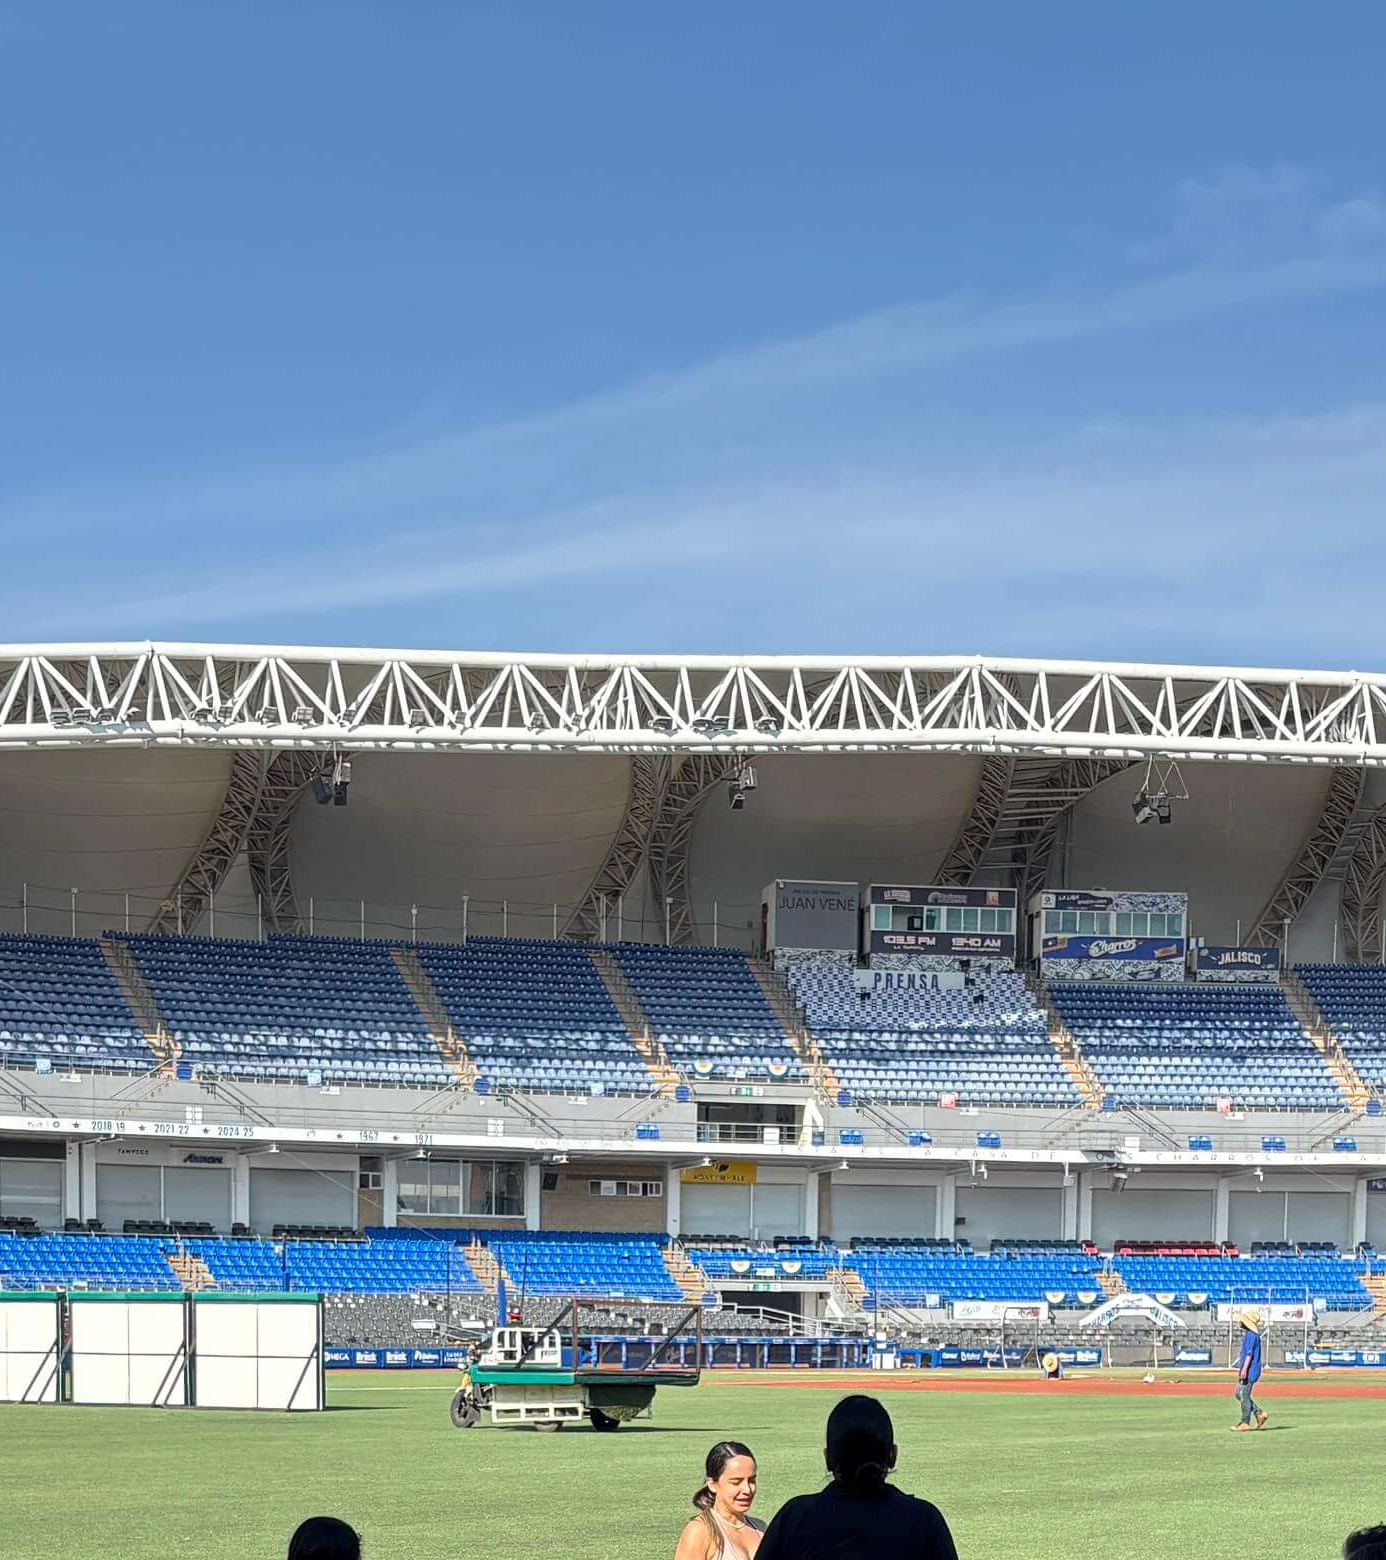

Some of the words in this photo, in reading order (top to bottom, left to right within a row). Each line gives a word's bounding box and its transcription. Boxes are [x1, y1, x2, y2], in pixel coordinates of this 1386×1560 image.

[779, 896, 815, 909] JUAN
[820, 896, 856, 911] VENÉ
[917, 936, 936, 946] FM
[984, 938, 1001, 948] AM
[1088, 939, 1137, 957] Charros
[1217, 951, 1261, 965] JALISCO
[874, 972, 939, 992] PRENSA
[415, 1134, 433, 1146] 1971
